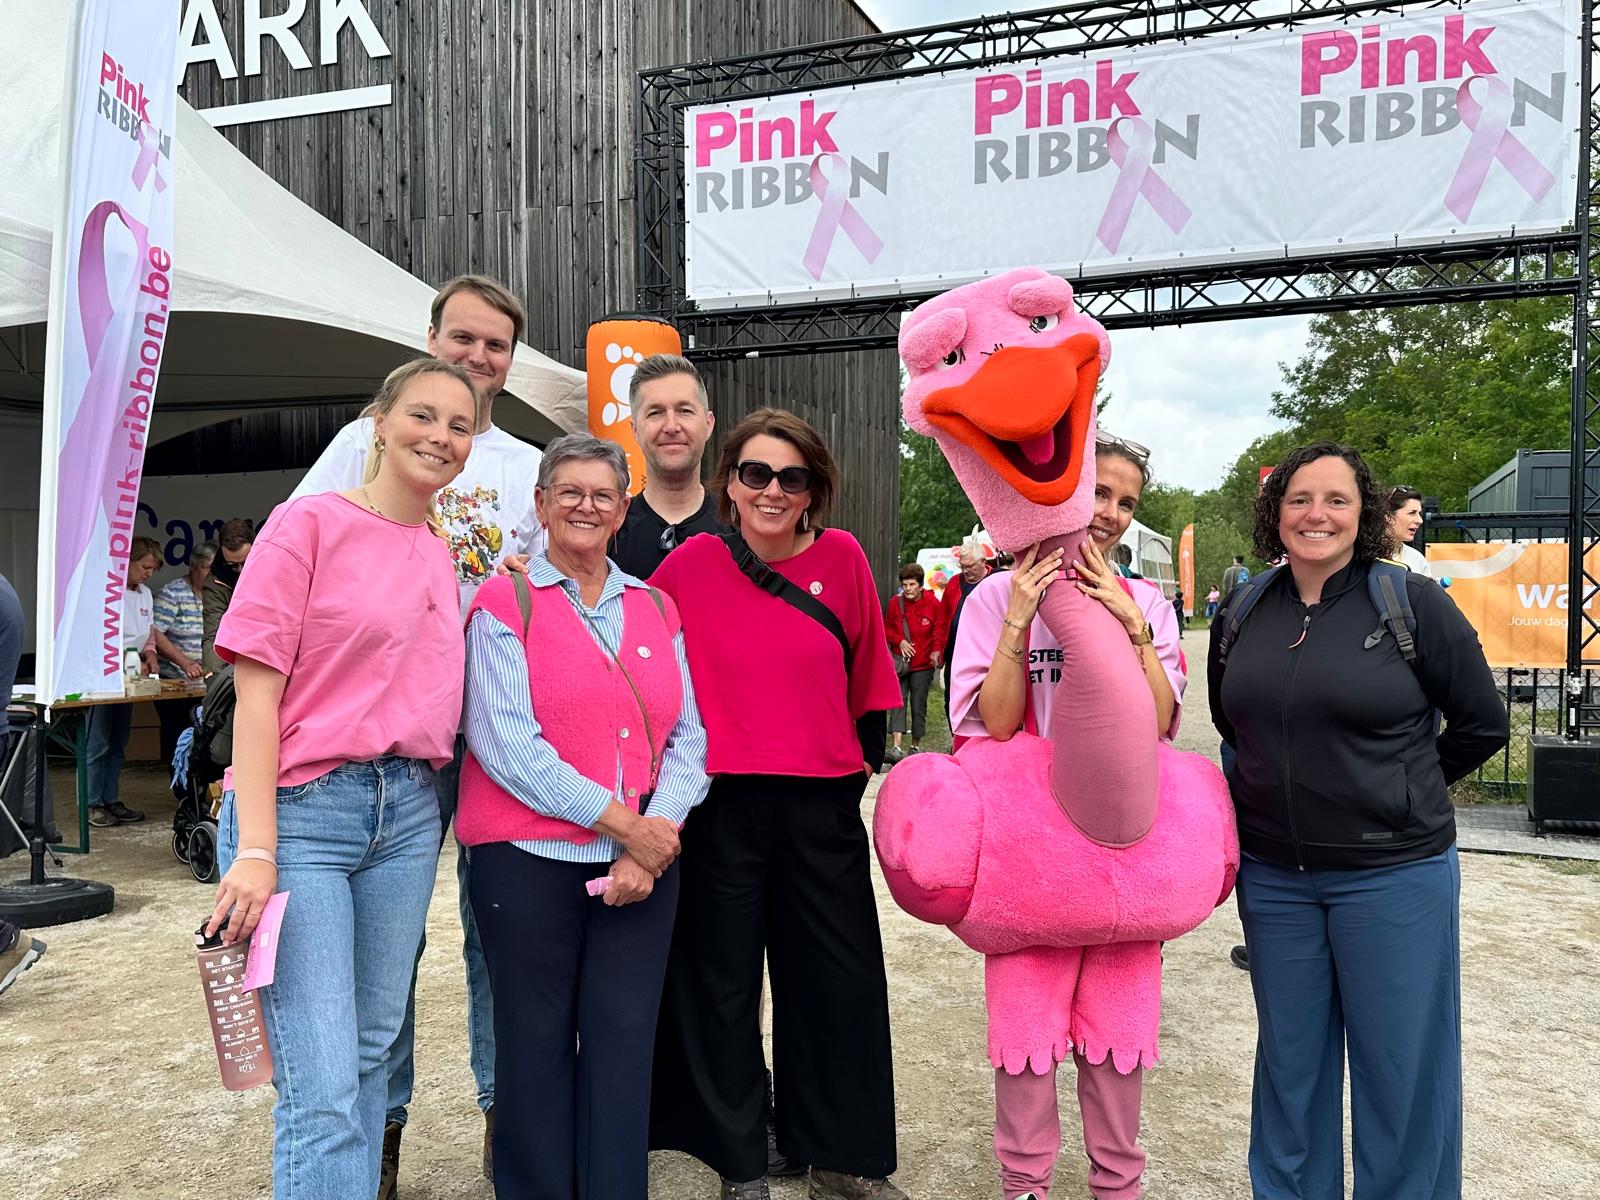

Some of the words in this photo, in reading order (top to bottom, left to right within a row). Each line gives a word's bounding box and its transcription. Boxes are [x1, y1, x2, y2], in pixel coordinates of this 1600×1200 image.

[100, 50, 151, 124] Pink
[1301, 14, 1498, 96] Pink
[695, 100, 838, 167] Pink
[975, 59, 1141, 135] Pink
[1300, 72, 1566, 148] RIBBON
[696, 152, 889, 213] RIBBON
[974, 114, 1200, 184] RIBBON
[103, 246, 171, 677] www.pink-ribbon.be
[1508, 617, 1541, 626] Jouw
